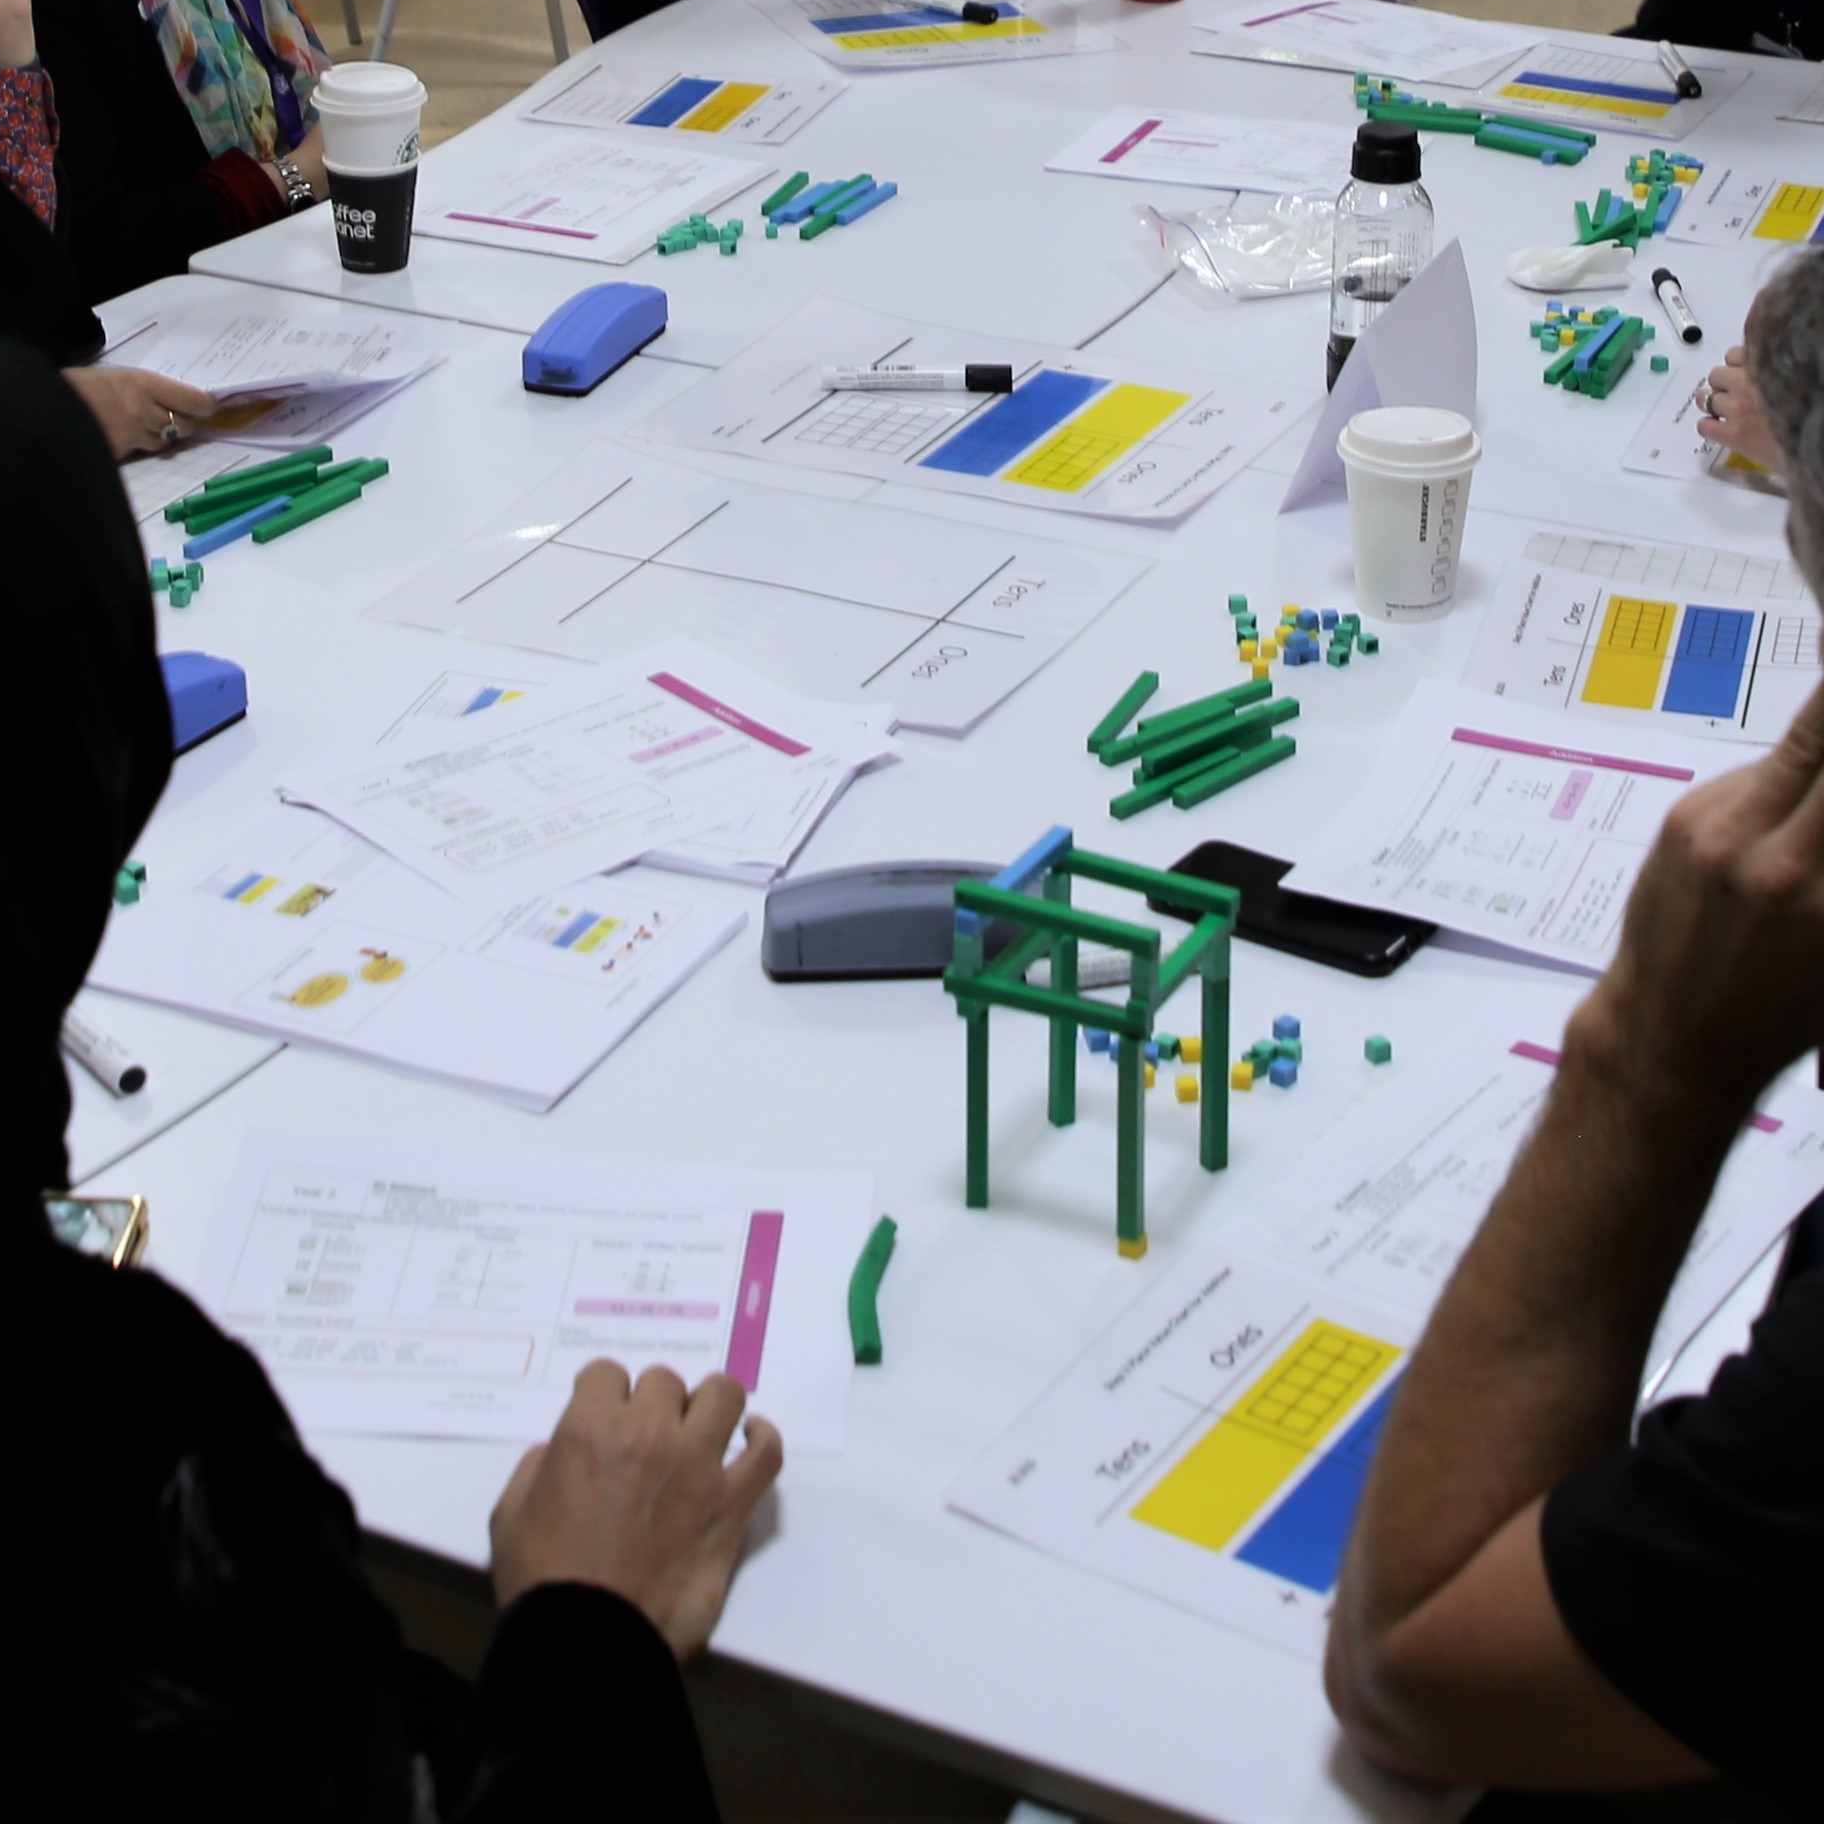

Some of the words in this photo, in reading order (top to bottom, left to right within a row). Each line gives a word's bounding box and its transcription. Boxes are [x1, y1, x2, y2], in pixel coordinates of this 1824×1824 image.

[1419, 484, 1430, 543] STARBUCKS
[992, 578, 1047, 608] Tens
[1563, 601, 1586, 626] Ones
[911, 645, 968, 678] Ones
[1210, 1325, 1263, 1368] Ones
[1094, 1438, 1151, 1480] Tens
